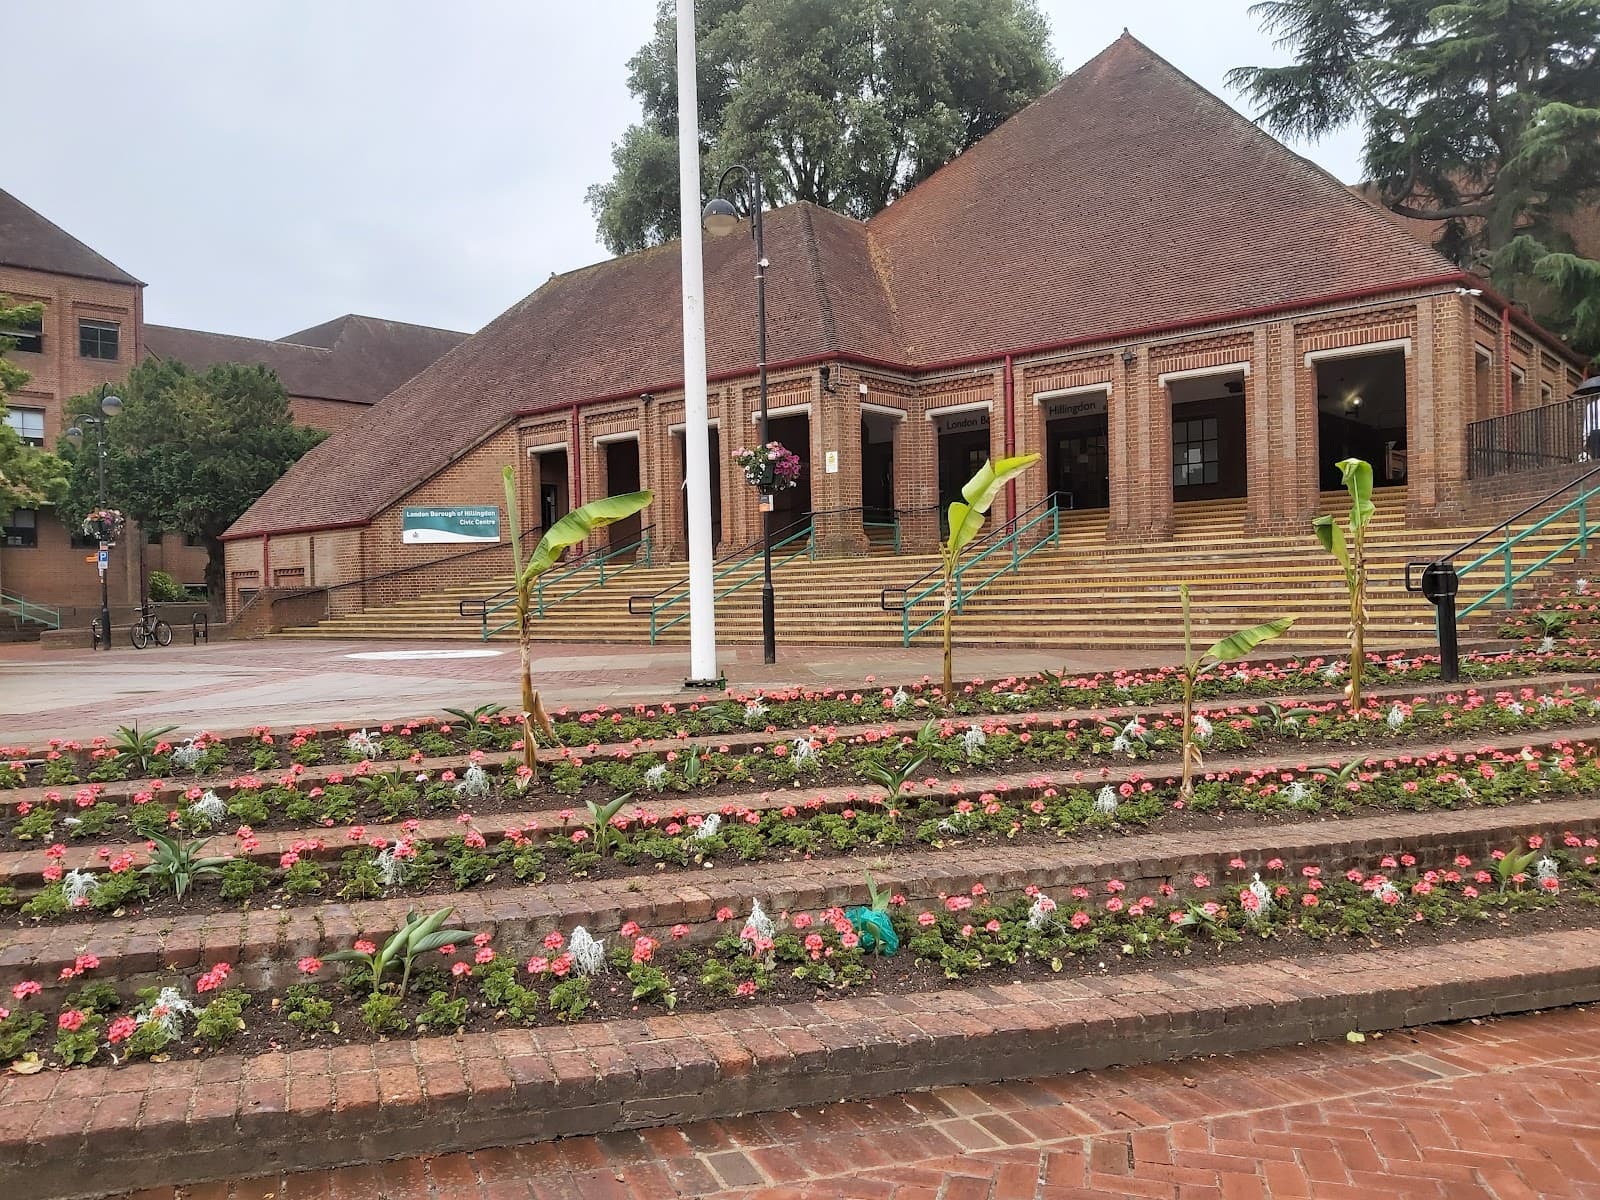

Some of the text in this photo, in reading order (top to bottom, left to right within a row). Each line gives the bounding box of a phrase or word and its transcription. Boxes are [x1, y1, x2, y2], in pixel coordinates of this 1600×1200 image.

[1049, 401, 1096, 416] Hillingdon
[946, 418, 978, 430] London
[430, 510, 457, 518] Borough
[100, 552, 107, 560] P
